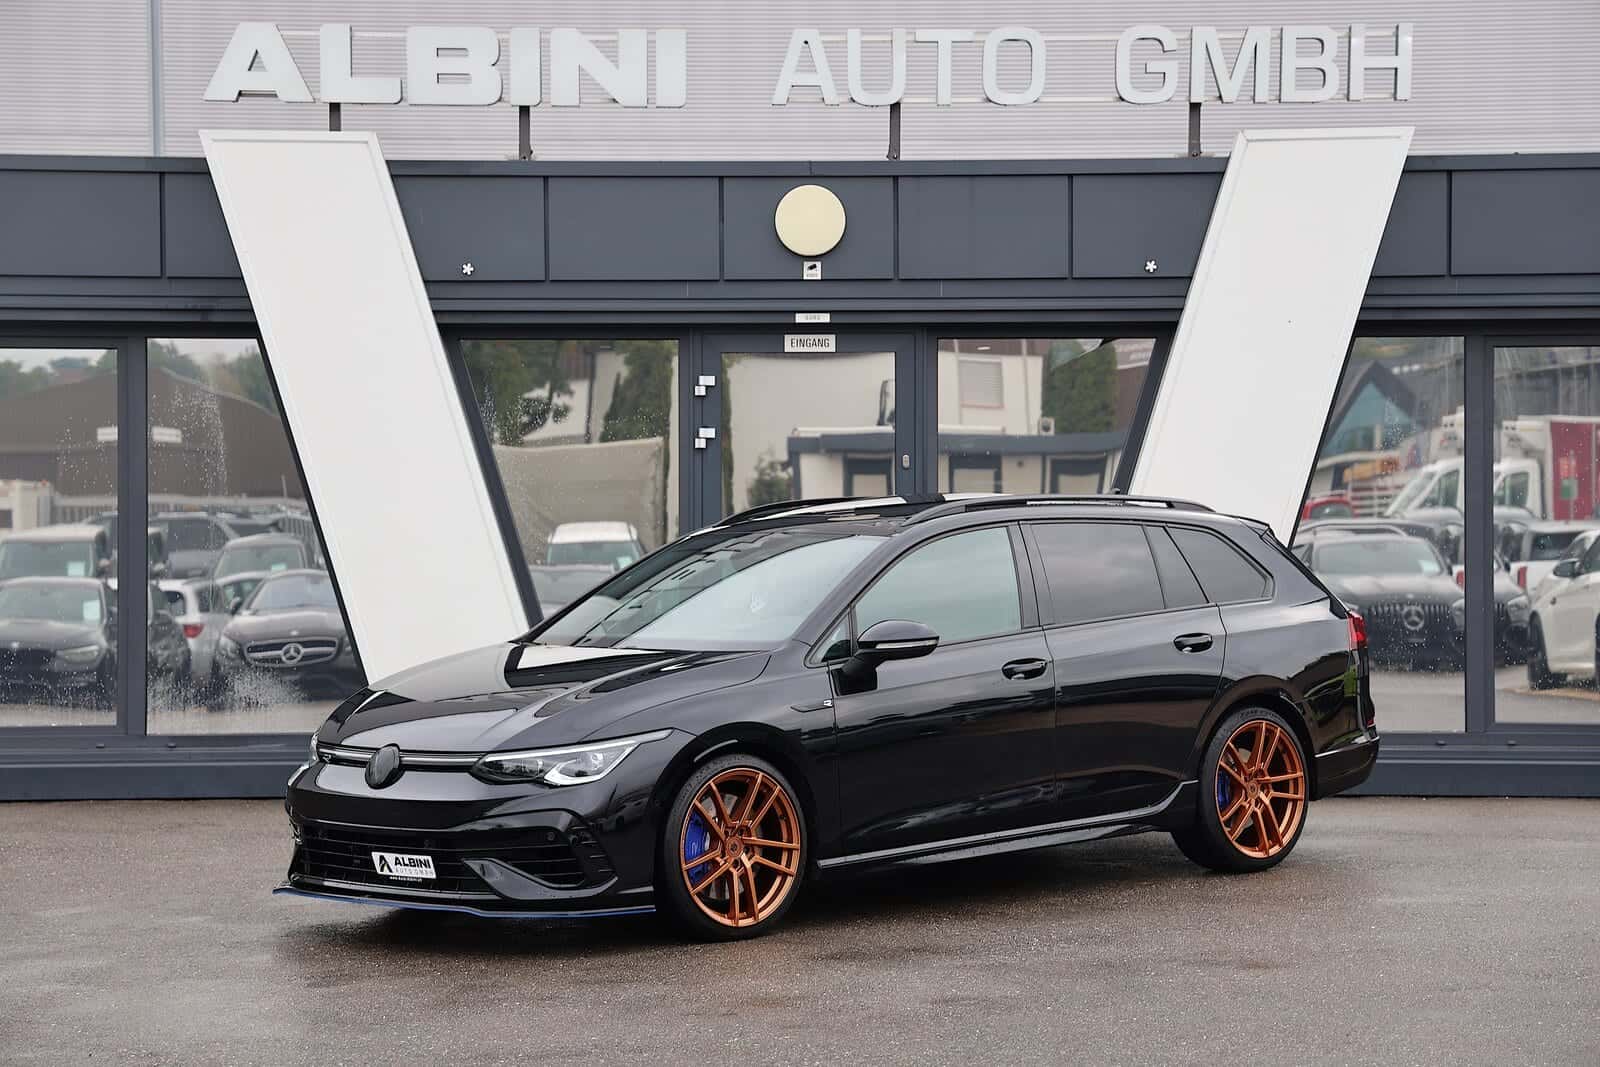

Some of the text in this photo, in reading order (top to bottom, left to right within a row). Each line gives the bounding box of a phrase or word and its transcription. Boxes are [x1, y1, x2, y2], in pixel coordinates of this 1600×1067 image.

[202, 22, 1413, 108] ALBINI AUTO GMBH
[791, 338, 830, 348] EINGANG
[394, 856, 432, 869] ALBINI
